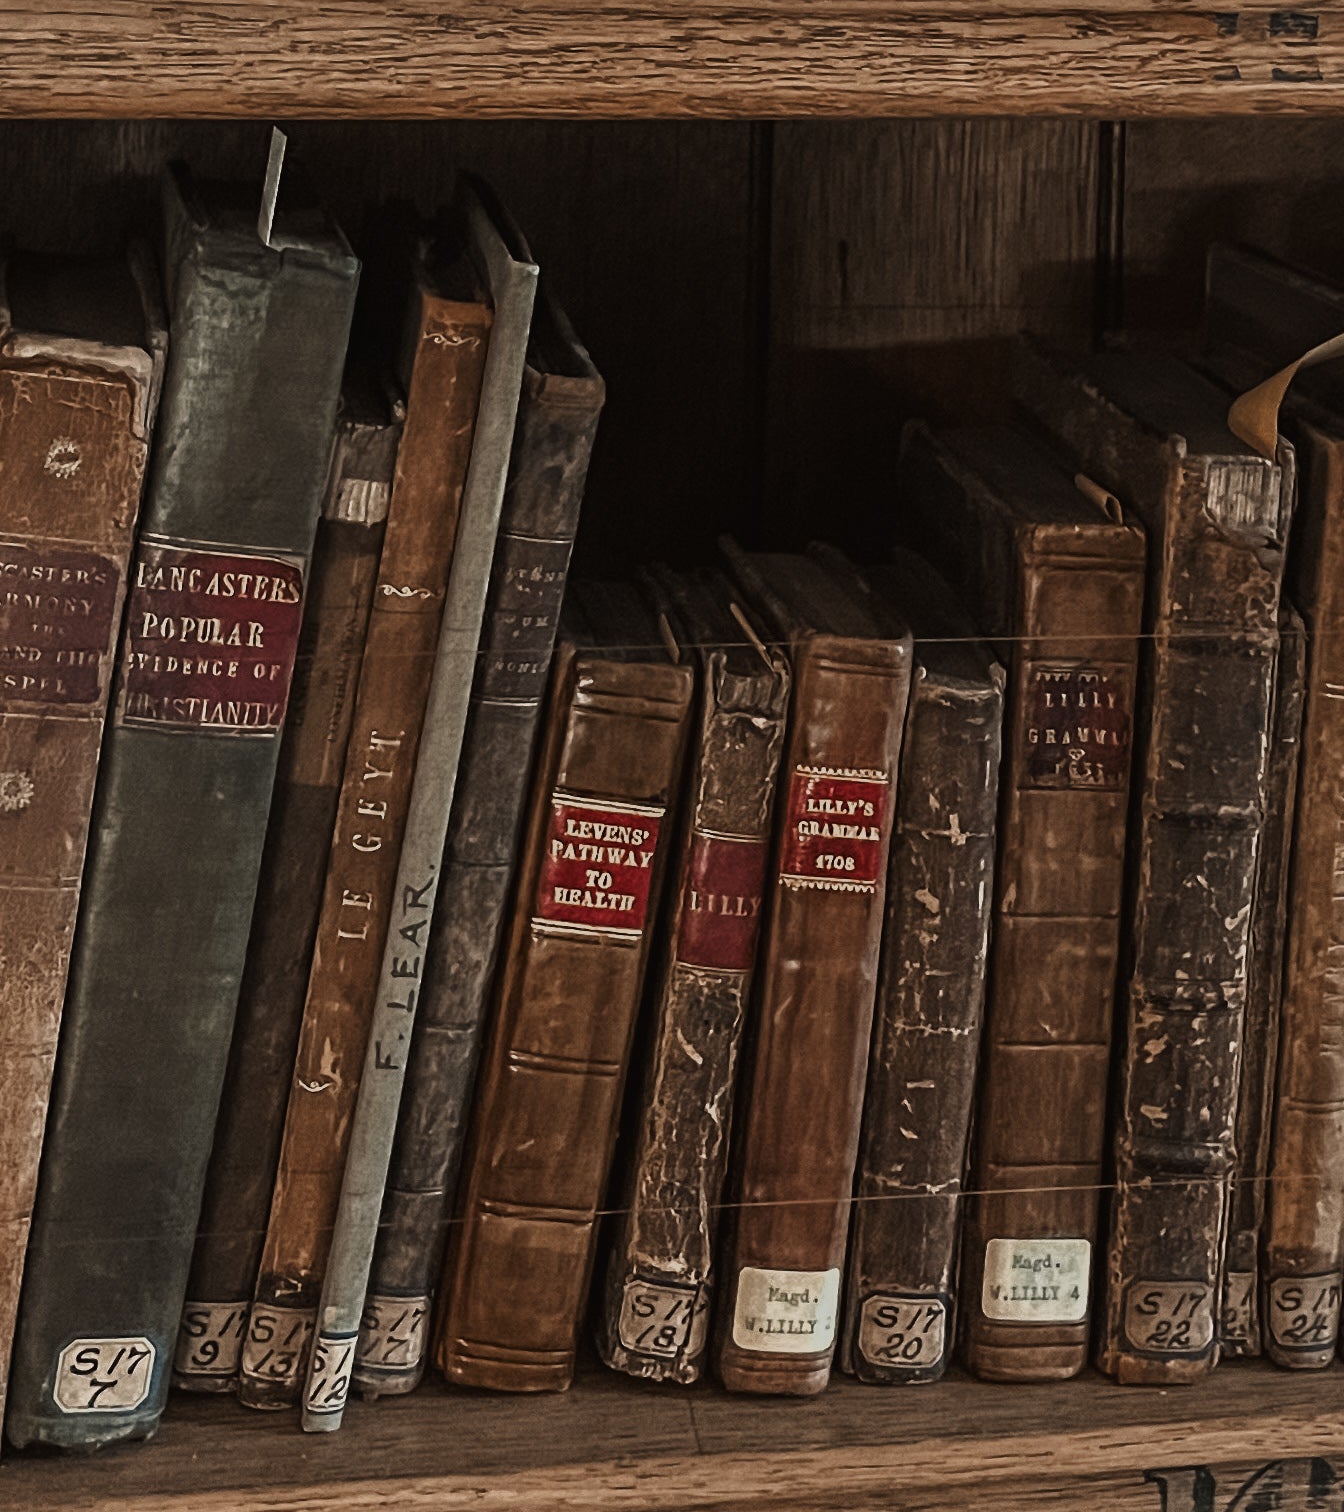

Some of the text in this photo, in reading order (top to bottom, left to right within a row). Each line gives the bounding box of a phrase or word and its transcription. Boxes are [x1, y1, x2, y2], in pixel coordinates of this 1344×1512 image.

[141, 611, 266, 649] POPULAR
[126, 651, 282, 682] EVIDENCE OF
[1044, 691, 1117, 709] LILLY
[806, 797, 876, 818] LILLY'S
[564, 818, 650, 847] LEVENS'
[797, 819, 881, 843] GRAMMAR
[551, 838, 655, 869] PATHWAY
[815, 853, 856, 872] 1708
[585, 869, 613, 890] TO
[554, 888, 636, 913] HEALTH
[688, 891, 759, 917] LILLY
[337, 888, 375, 941] LE
[373, 862, 437, 1071] F. LEAR.
[1011, 1252, 1063, 1272] Magd.
[632, 1291, 656, 1318] S
[768, 1286, 821, 1306] Magd.
[1069, 1286, 1081, 1301] 4
[1135, 1290, 1163, 1317] S
[1171, 1290, 1205, 1318] 17
[1275, 1289, 1302, 1313] S
[181, 1311, 210, 1338] S
[249, 1314, 278, 1342] S
[362, 1303, 381, 1332] S
[873, 1304, 942, 1332] S 17
[1288, 1315, 1329, 1336] 24
[1148, 1320, 1193, 1346] 22
[192, 1342, 220, 1368] 9
[256, 1347, 292, 1375] 13
[885, 1334, 923, 1361] 20
[68, 1347, 153, 1377] S 17
[86, 1379, 119, 1409] 7
[308, 1375, 348, 1403] 12
